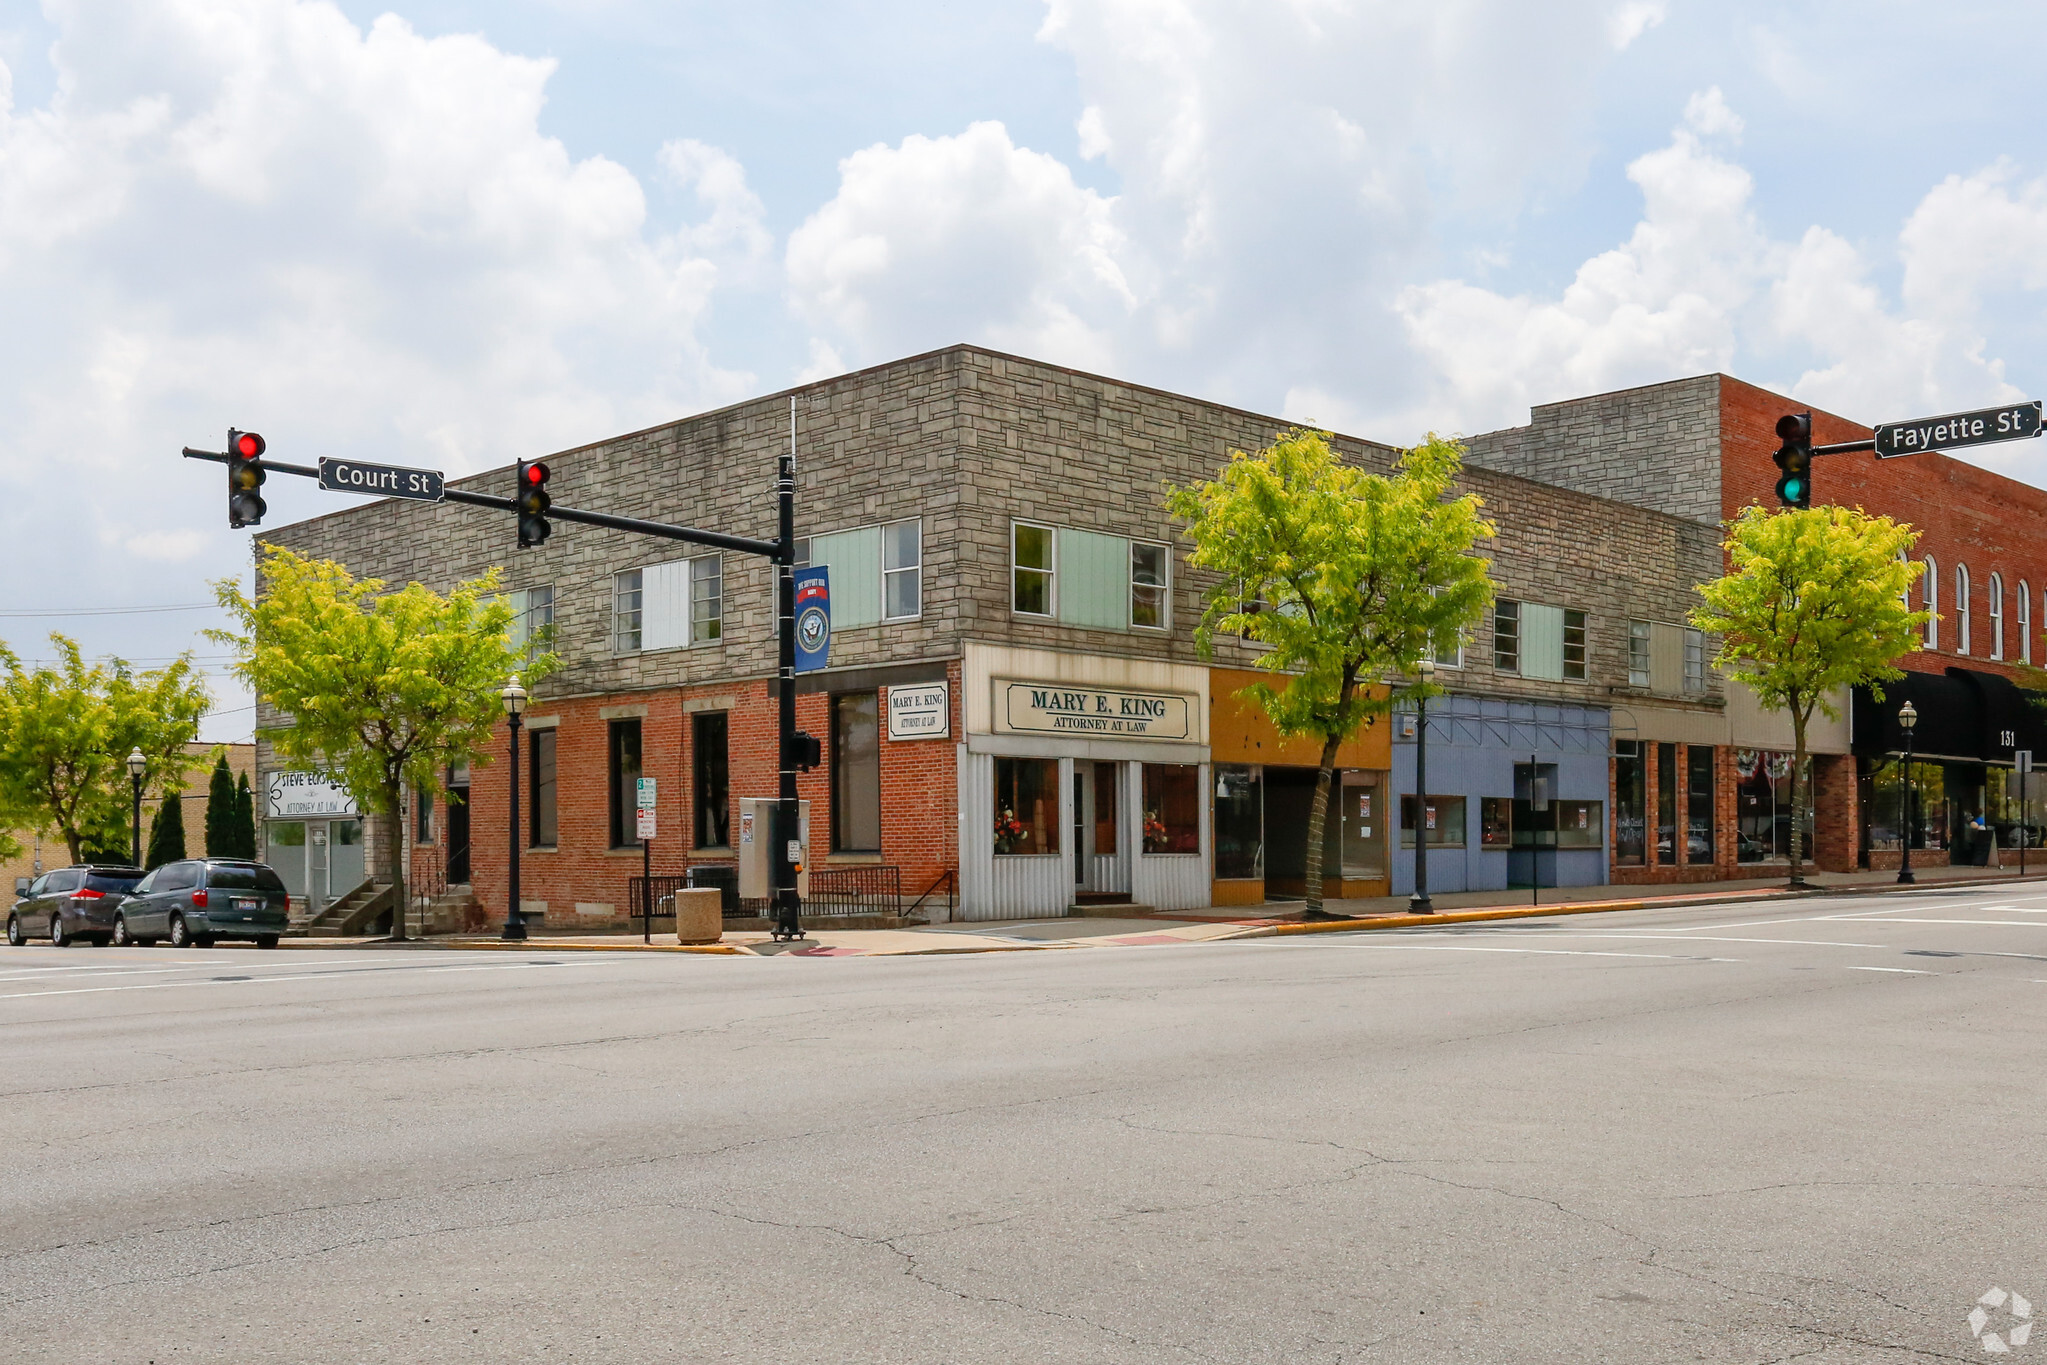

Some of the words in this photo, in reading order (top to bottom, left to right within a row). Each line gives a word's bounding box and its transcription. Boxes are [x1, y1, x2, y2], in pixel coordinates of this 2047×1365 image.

[1893, 418, 1984, 449] Fayette
[1997, 410, 2022, 432] St
[335, 465, 398, 489] Court
[408, 473, 430, 493] St
[892, 696, 913, 708] MARY
[915, 695, 922, 706] E.
[924, 694, 942, 706] KING
[1031, 690, 1088, 712] MARY
[1096, 695, 1112, 714] E.
[1120, 697, 1165, 718] KING
[901, 717, 920, 728] ATTORNEY
[921, 717, 927, 727] AT
[927, 716, 936, 726] LAW
[1054, 717, 1108, 730] ATTORNEY
[1111, 720, 1123, 731] AT
[1127, 721, 1147, 732] LAW
[2000, 730, 2015, 747] 131
[282, 773, 303, 787] STEVE
[287, 802, 315, 813] ATTORNEY
[317, 801, 324, 812] AT
[326, 801, 338, 811] LAW
